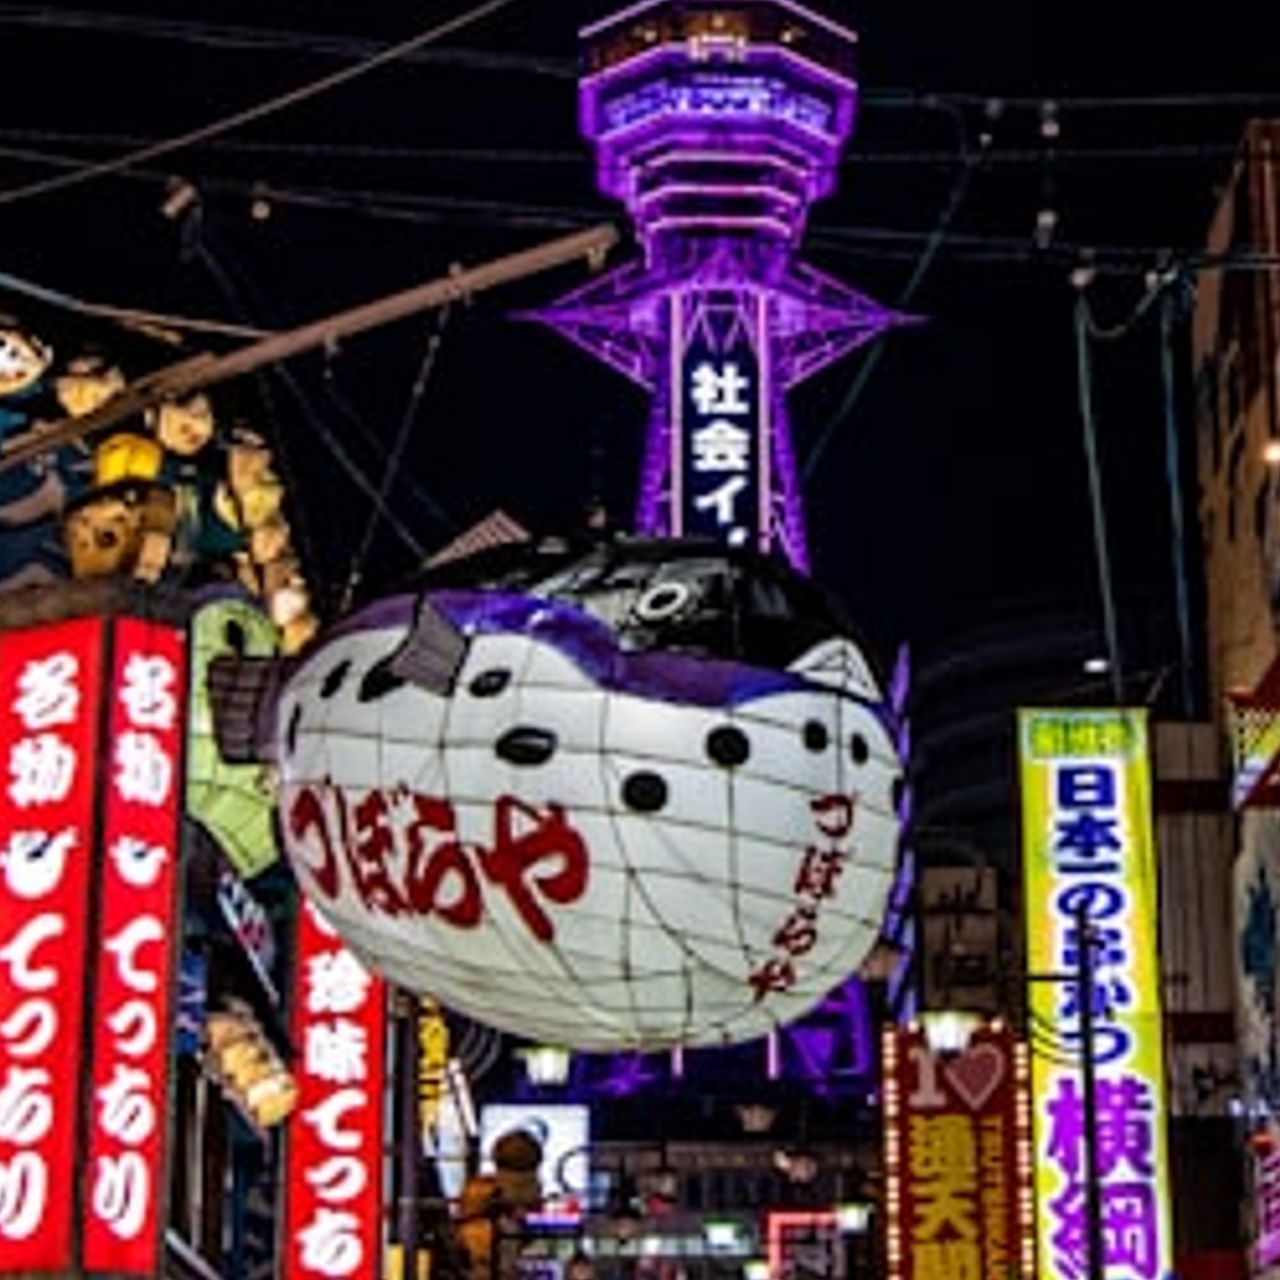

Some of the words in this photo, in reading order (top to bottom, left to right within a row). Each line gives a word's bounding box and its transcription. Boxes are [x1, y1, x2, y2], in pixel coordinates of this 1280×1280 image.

[690, 362, 749, 546] 社会イ
[93, 916, 166, 1240] てっちり
